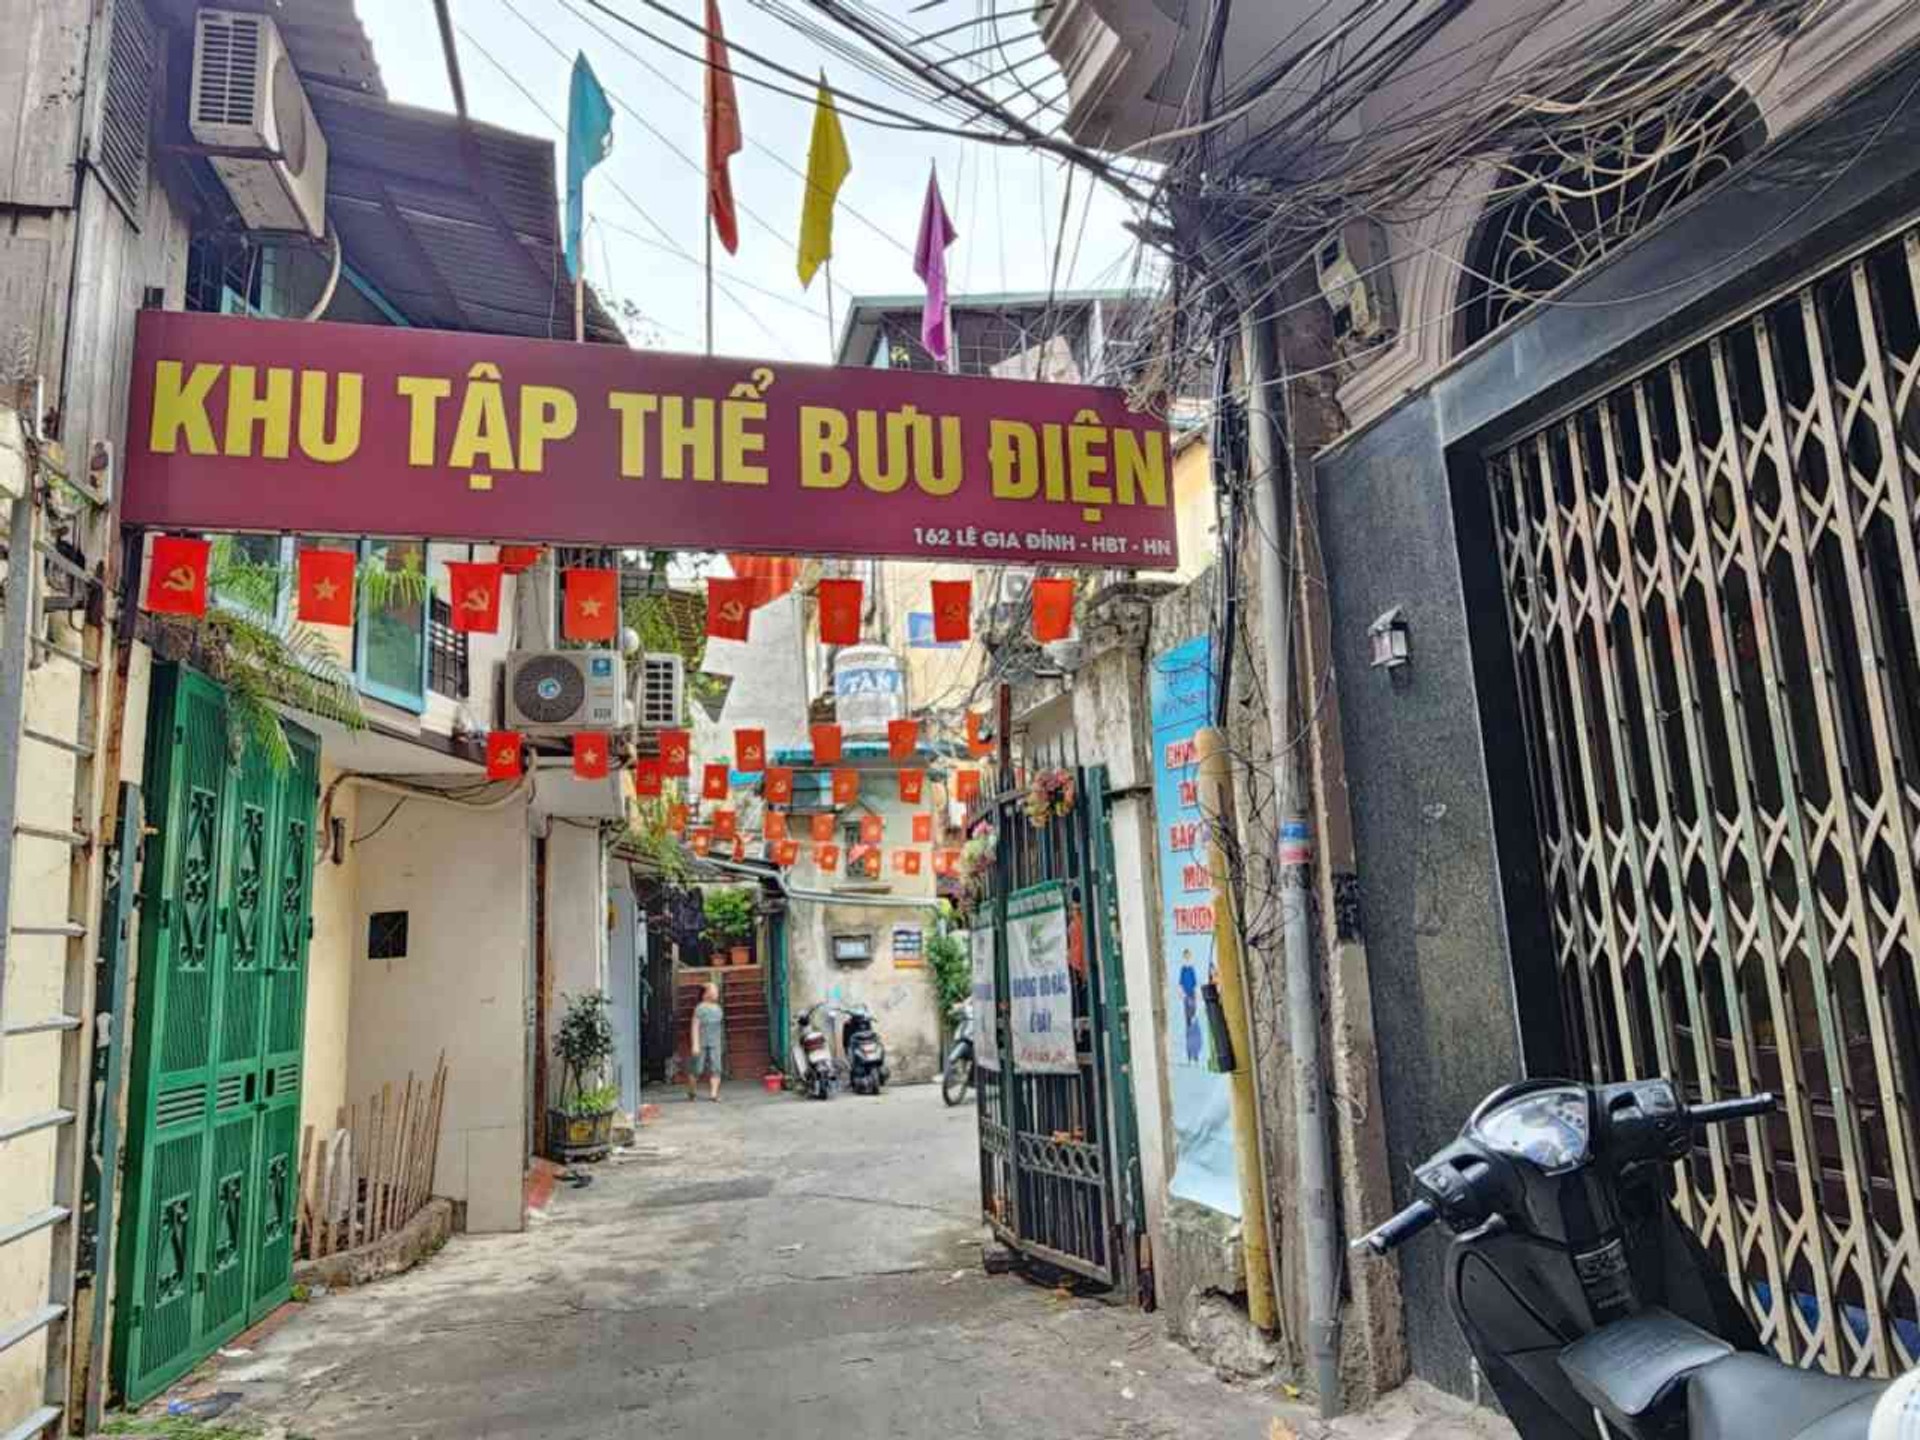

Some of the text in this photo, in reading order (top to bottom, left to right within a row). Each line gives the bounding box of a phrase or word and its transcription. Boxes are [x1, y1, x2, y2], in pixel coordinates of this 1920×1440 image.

[150, 360, 1167, 522] KHU TẬP THỂ BƯU ĐIỆN
[914, 527, 951, 546] 162
[956, 525, 978, 546] LÊ
[983, 531, 1021, 549] GIA
[1092, 535, 1127, 553] HBT
[1143, 537, 1172, 556] HN
